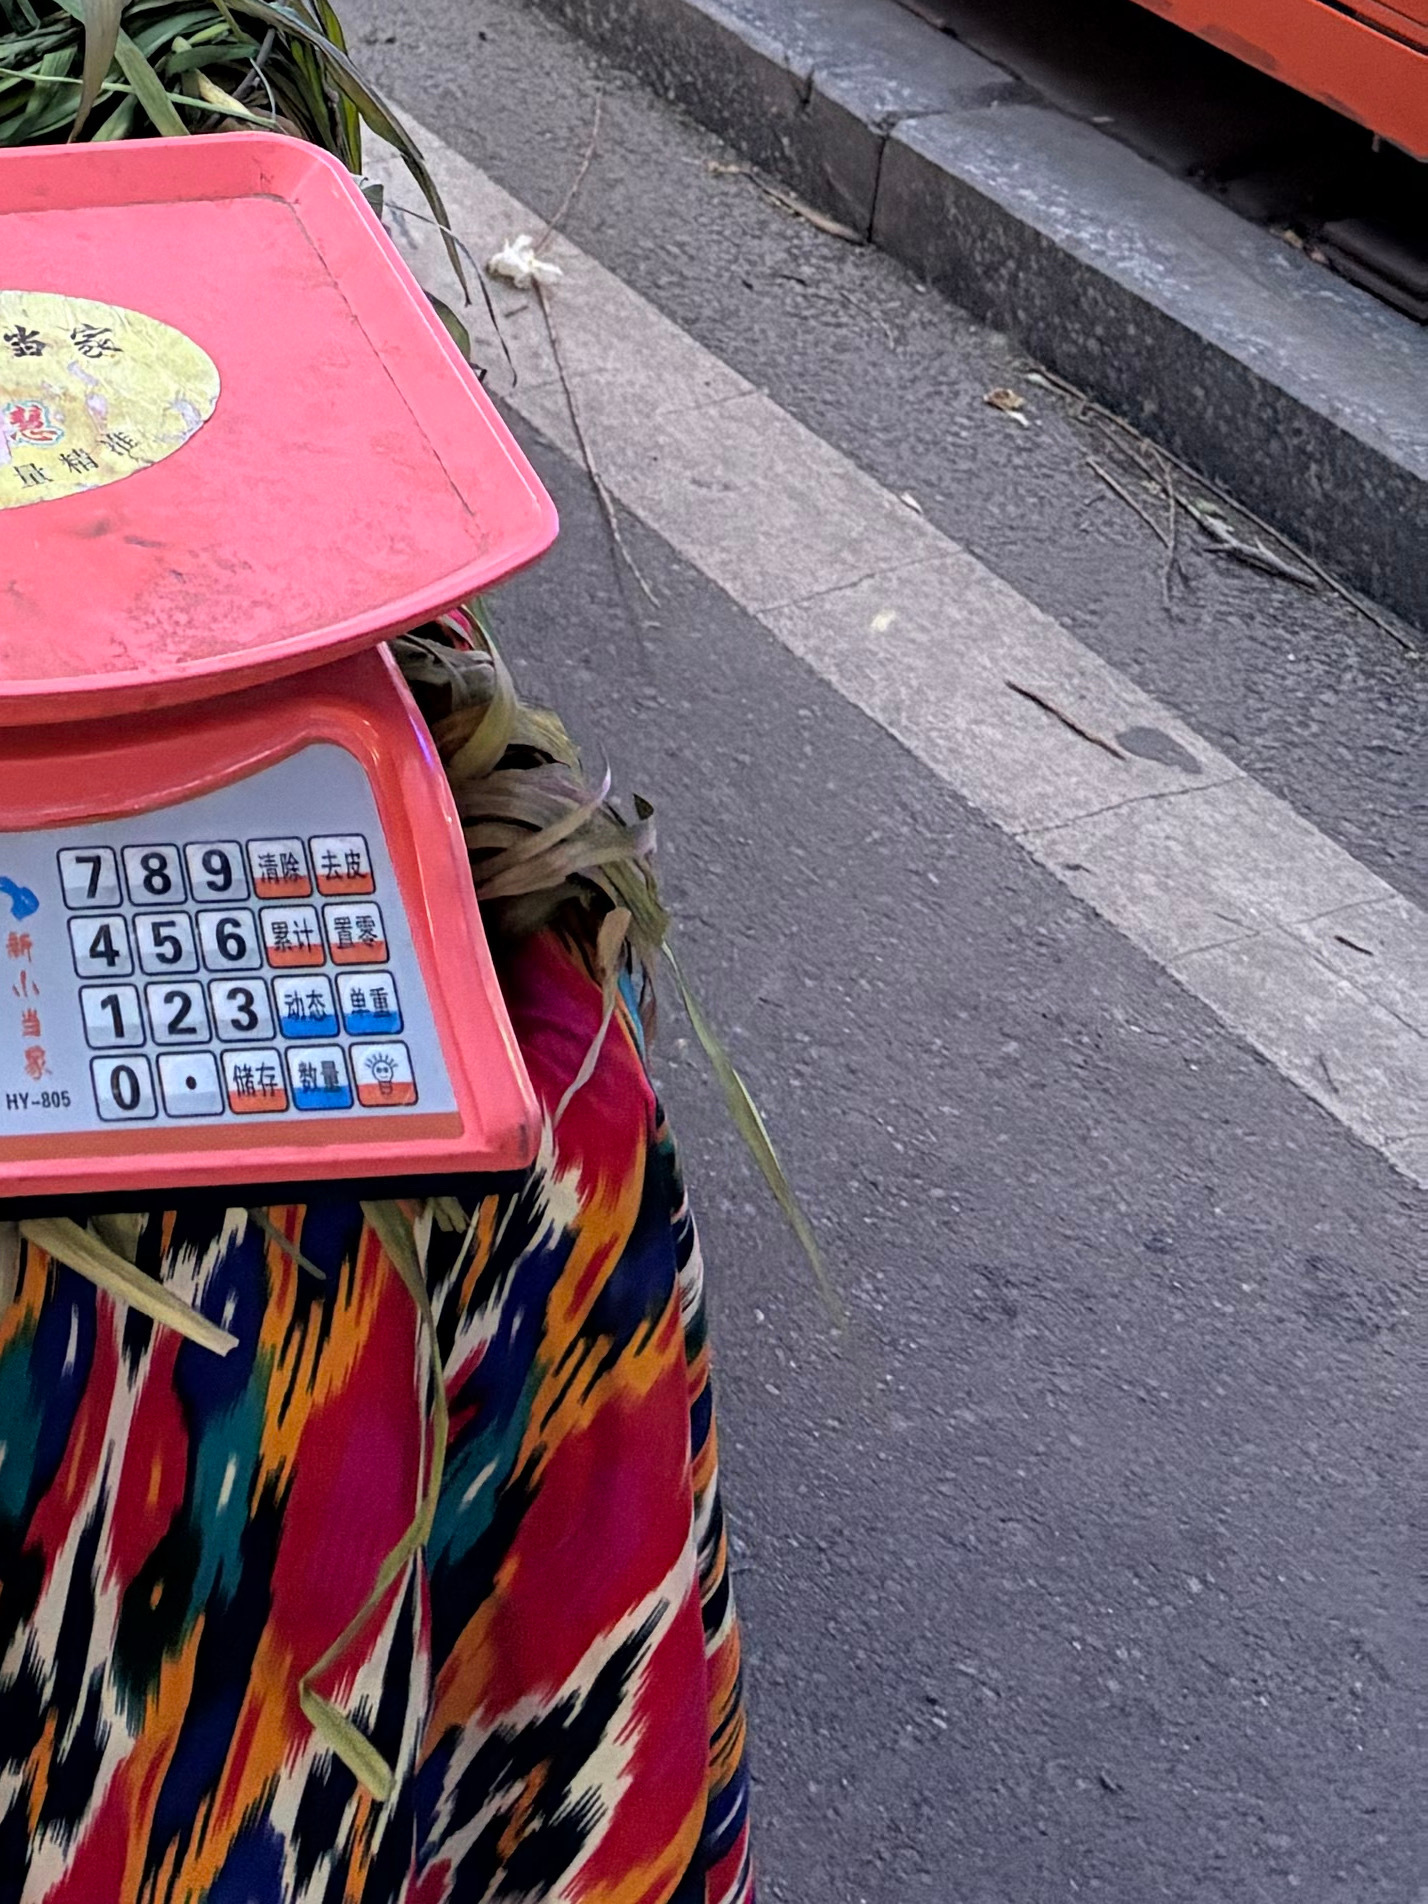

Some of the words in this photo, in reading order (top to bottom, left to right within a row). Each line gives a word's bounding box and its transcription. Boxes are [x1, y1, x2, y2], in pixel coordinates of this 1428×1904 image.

[75, 856, 102, 899] 7
[140, 852, 172, 895] 8
[201, 849, 233, 892] 9
[258, 852, 303, 884] 清除
[320, 848, 366, 881] 去皮
[88, 924, 120, 967] 4
[152, 920, 183, 964] 5
[215, 917, 247, 961] 6
[271, 917, 314, 953] 累计
[333, 914, 377, 950] 置零
[6, 931, 53, 1080] 新小当家
[100, 994, 125, 1038] 1
[163, 991, 197, 1035] 2
[226, 987, 258, 1031] 3
[284, 990, 327, 1021] 动态
[348, 986, 390, 1019] 单重
[110, 1064, 141, 1111] 0
[233, 1061, 278, 1097] 储存
[297, 1060, 340, 1093] 数量
[6, 1091, 71, 1111] HY-805
